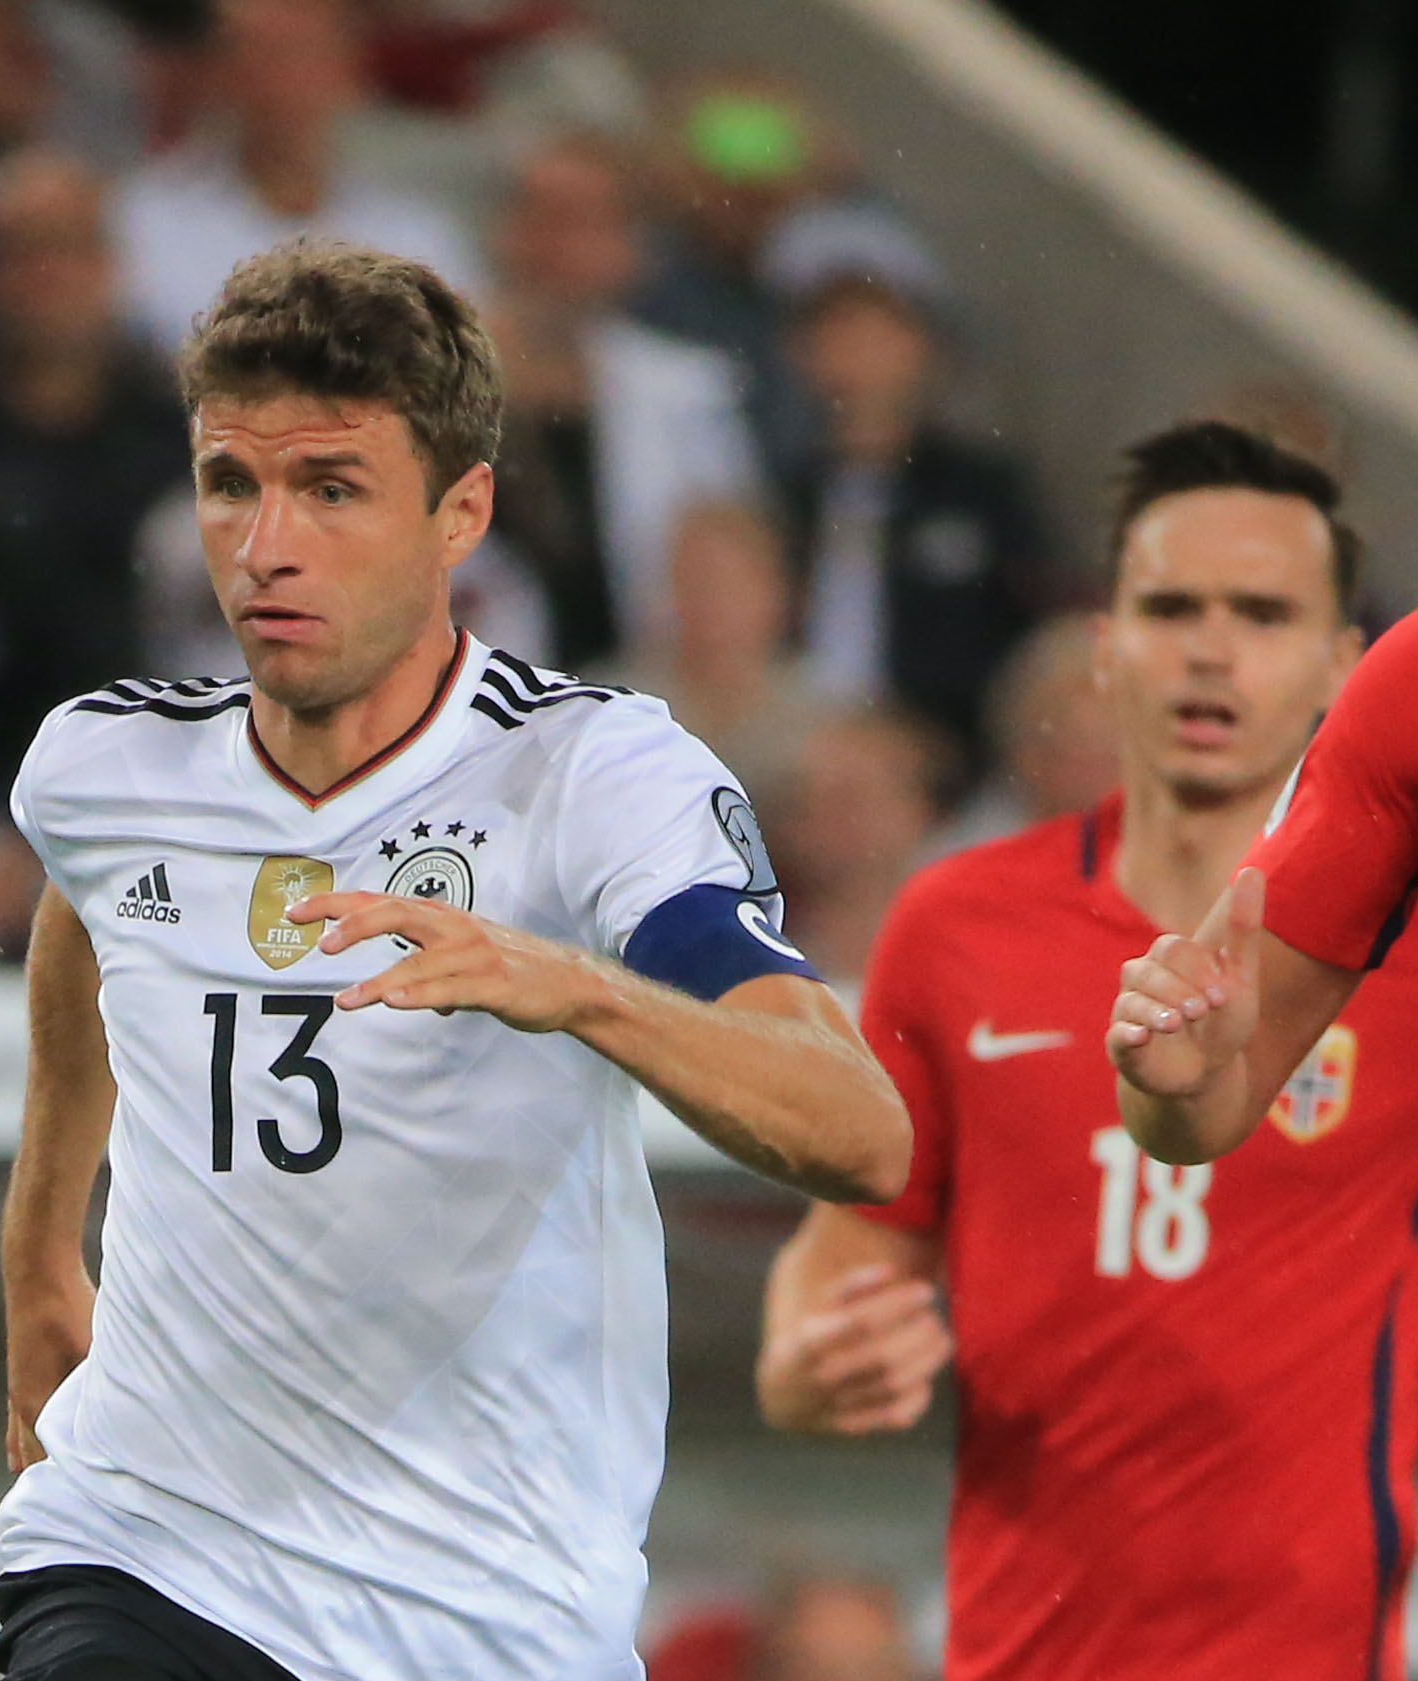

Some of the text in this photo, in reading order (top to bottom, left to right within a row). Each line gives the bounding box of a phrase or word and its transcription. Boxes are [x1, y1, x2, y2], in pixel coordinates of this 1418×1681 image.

[117, 898, 181, 924] adidas
[267, 928, 301, 944] FIFA
[269, 950, 293, 959] 2014
[203, 993, 343, 1175] 13
[1091, 1126, 1213, 1280] 18
